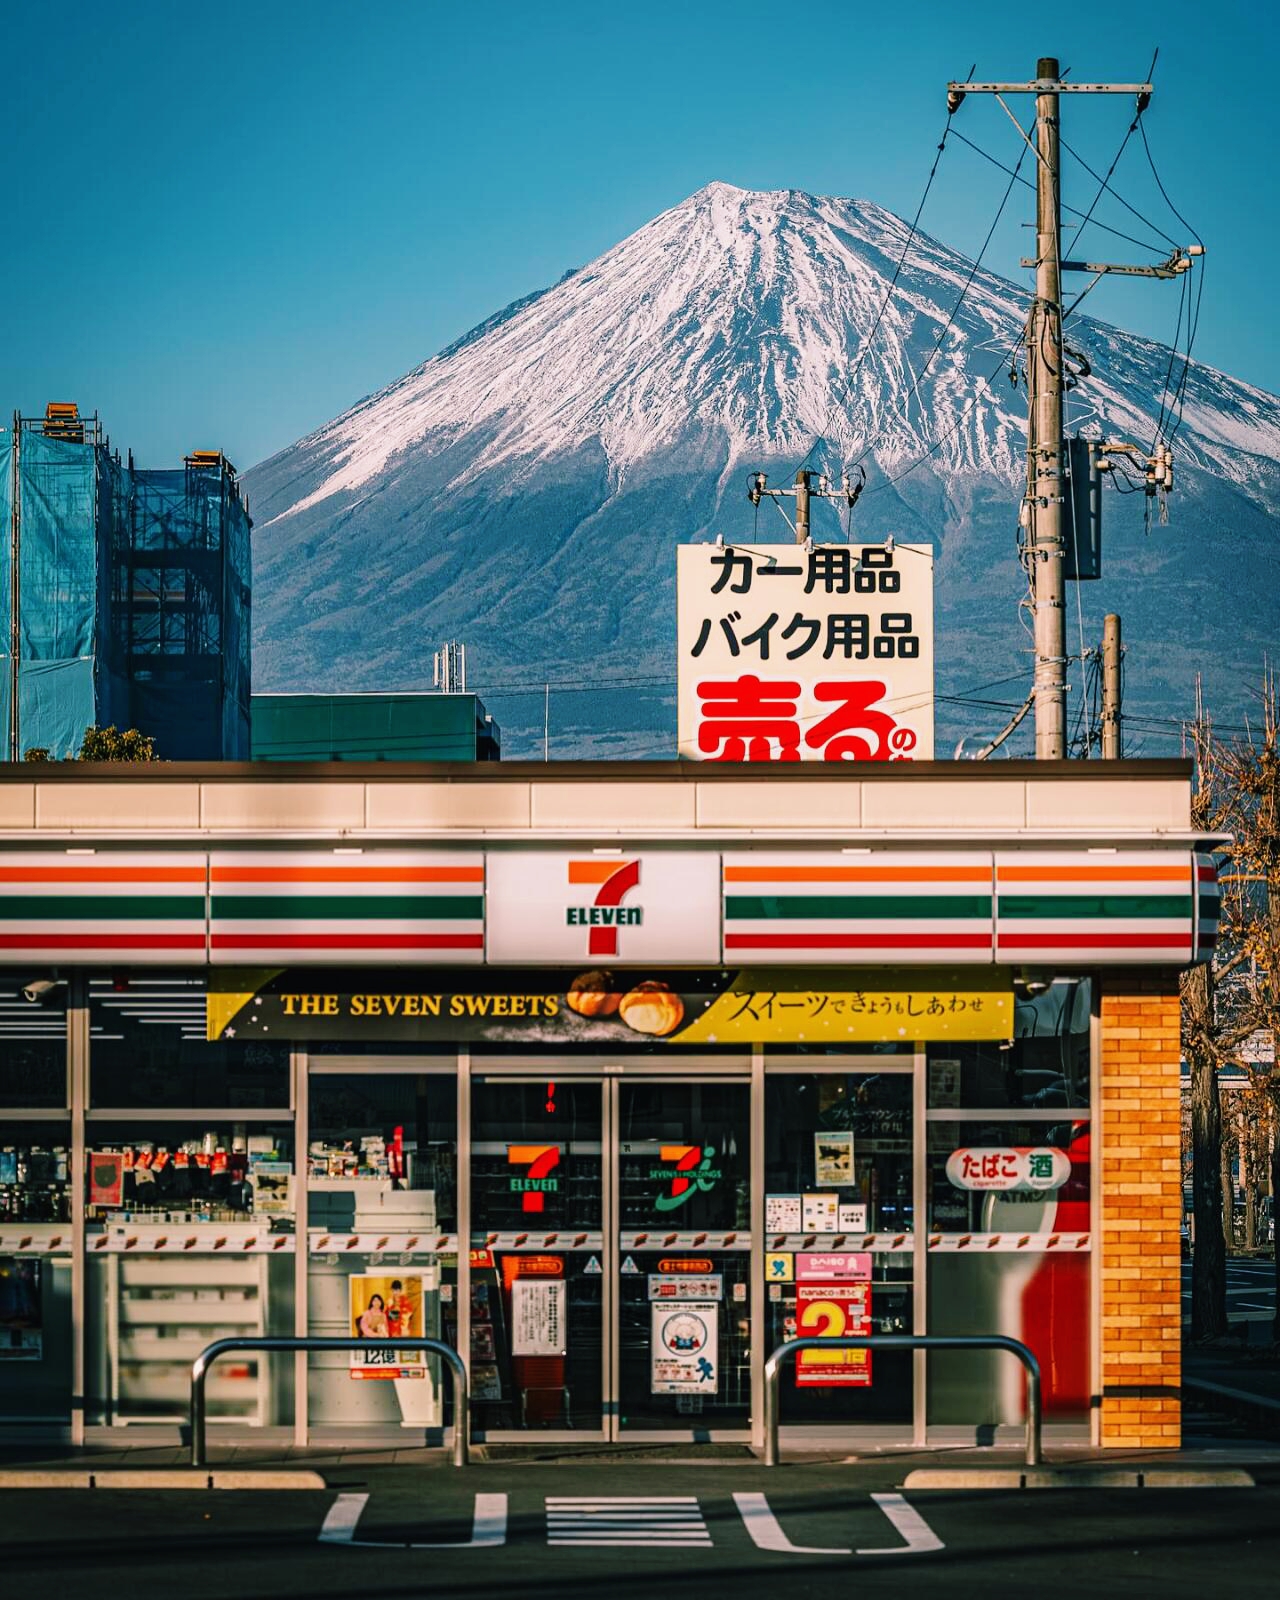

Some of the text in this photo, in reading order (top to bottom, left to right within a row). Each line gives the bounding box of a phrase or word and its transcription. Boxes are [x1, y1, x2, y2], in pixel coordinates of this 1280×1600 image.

[710, 548, 900, 594] カー用品
[691, 611, 919, 660] バイク用品
[281, 994, 559, 1017] THE SEVEN SWEETS
[962, 1154, 1053, 1178] たばこ 酒
